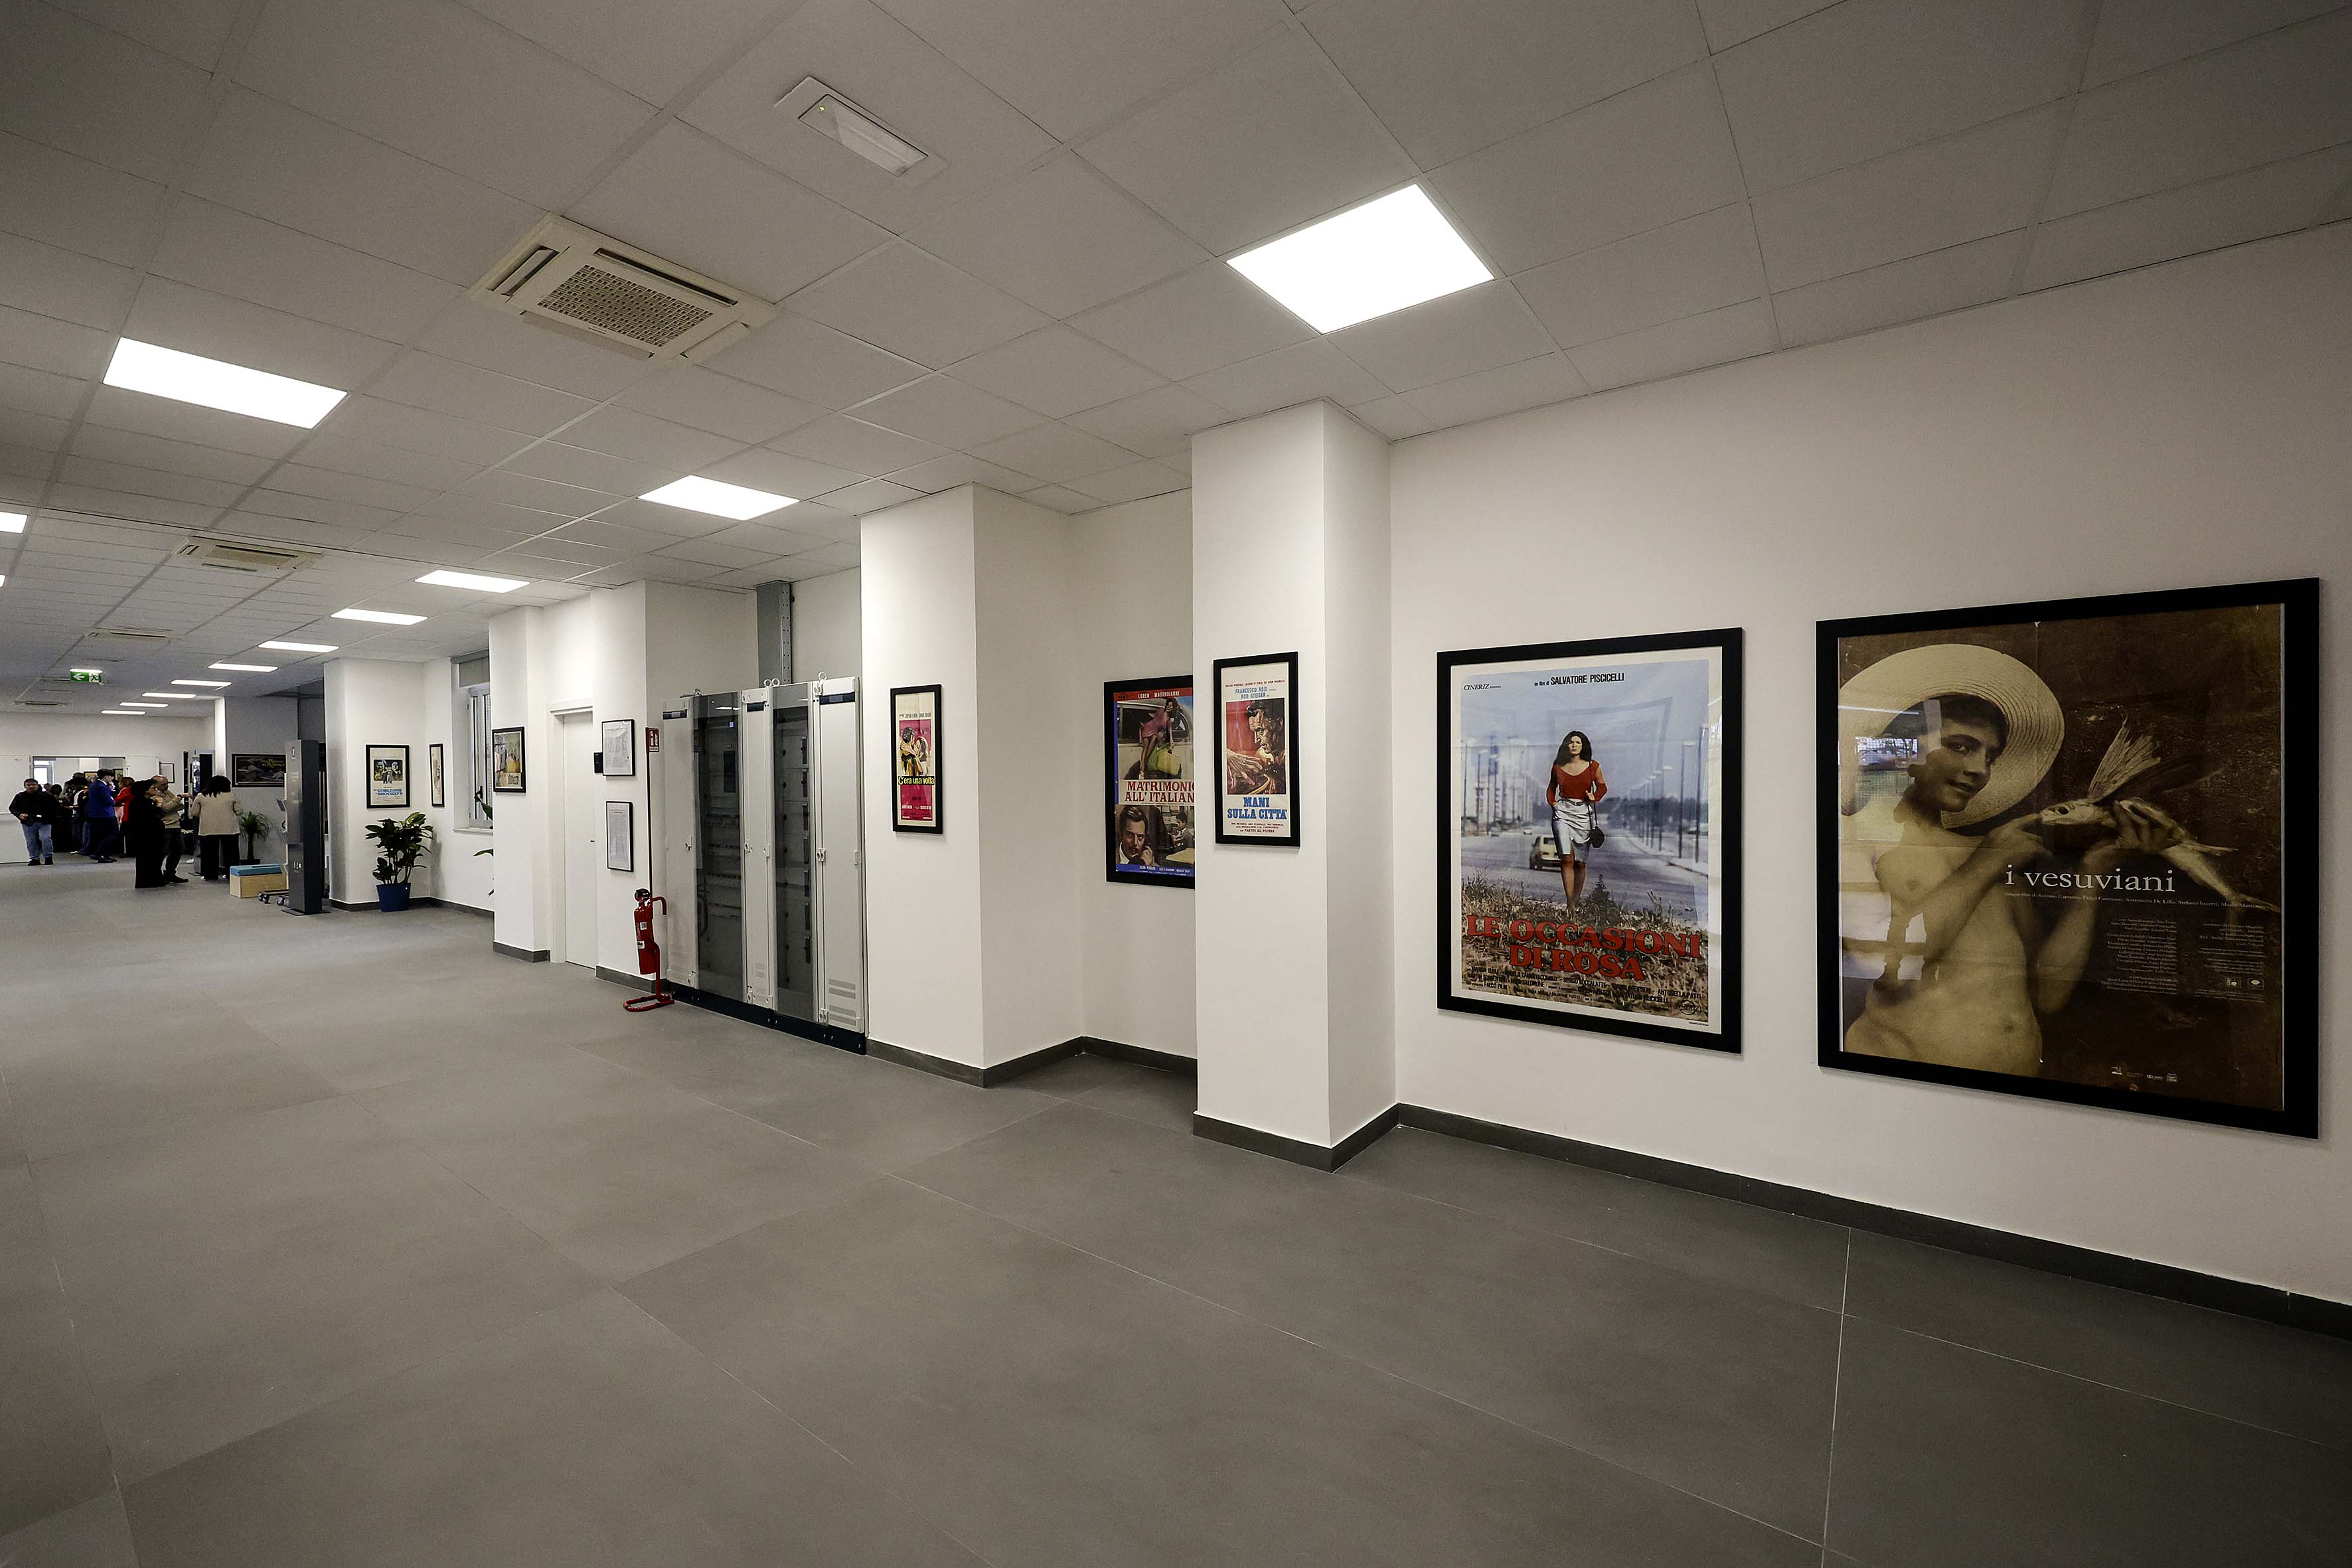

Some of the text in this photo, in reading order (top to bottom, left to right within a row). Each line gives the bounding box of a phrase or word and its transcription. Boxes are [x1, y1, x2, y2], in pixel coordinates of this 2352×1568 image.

[1550, 676, 1587, 686] SALVATORE
[1590, 672, 1625, 683] PISCICELLI
[1127, 781, 1194, 792] MATRIMONI
[1149, 791, 1194, 803] ITALIAN
[1243, 797, 1269, 808] MANI
[1227, 808, 1257, 819] SULLA
[2005, 864, 2175, 892] i vesuviani
[1466, 915, 1700, 958] LE OCCASIONI
[1509, 945, 1646, 981] DI ROSA
[1657, 988, 1686, 998] ANTONELLA
